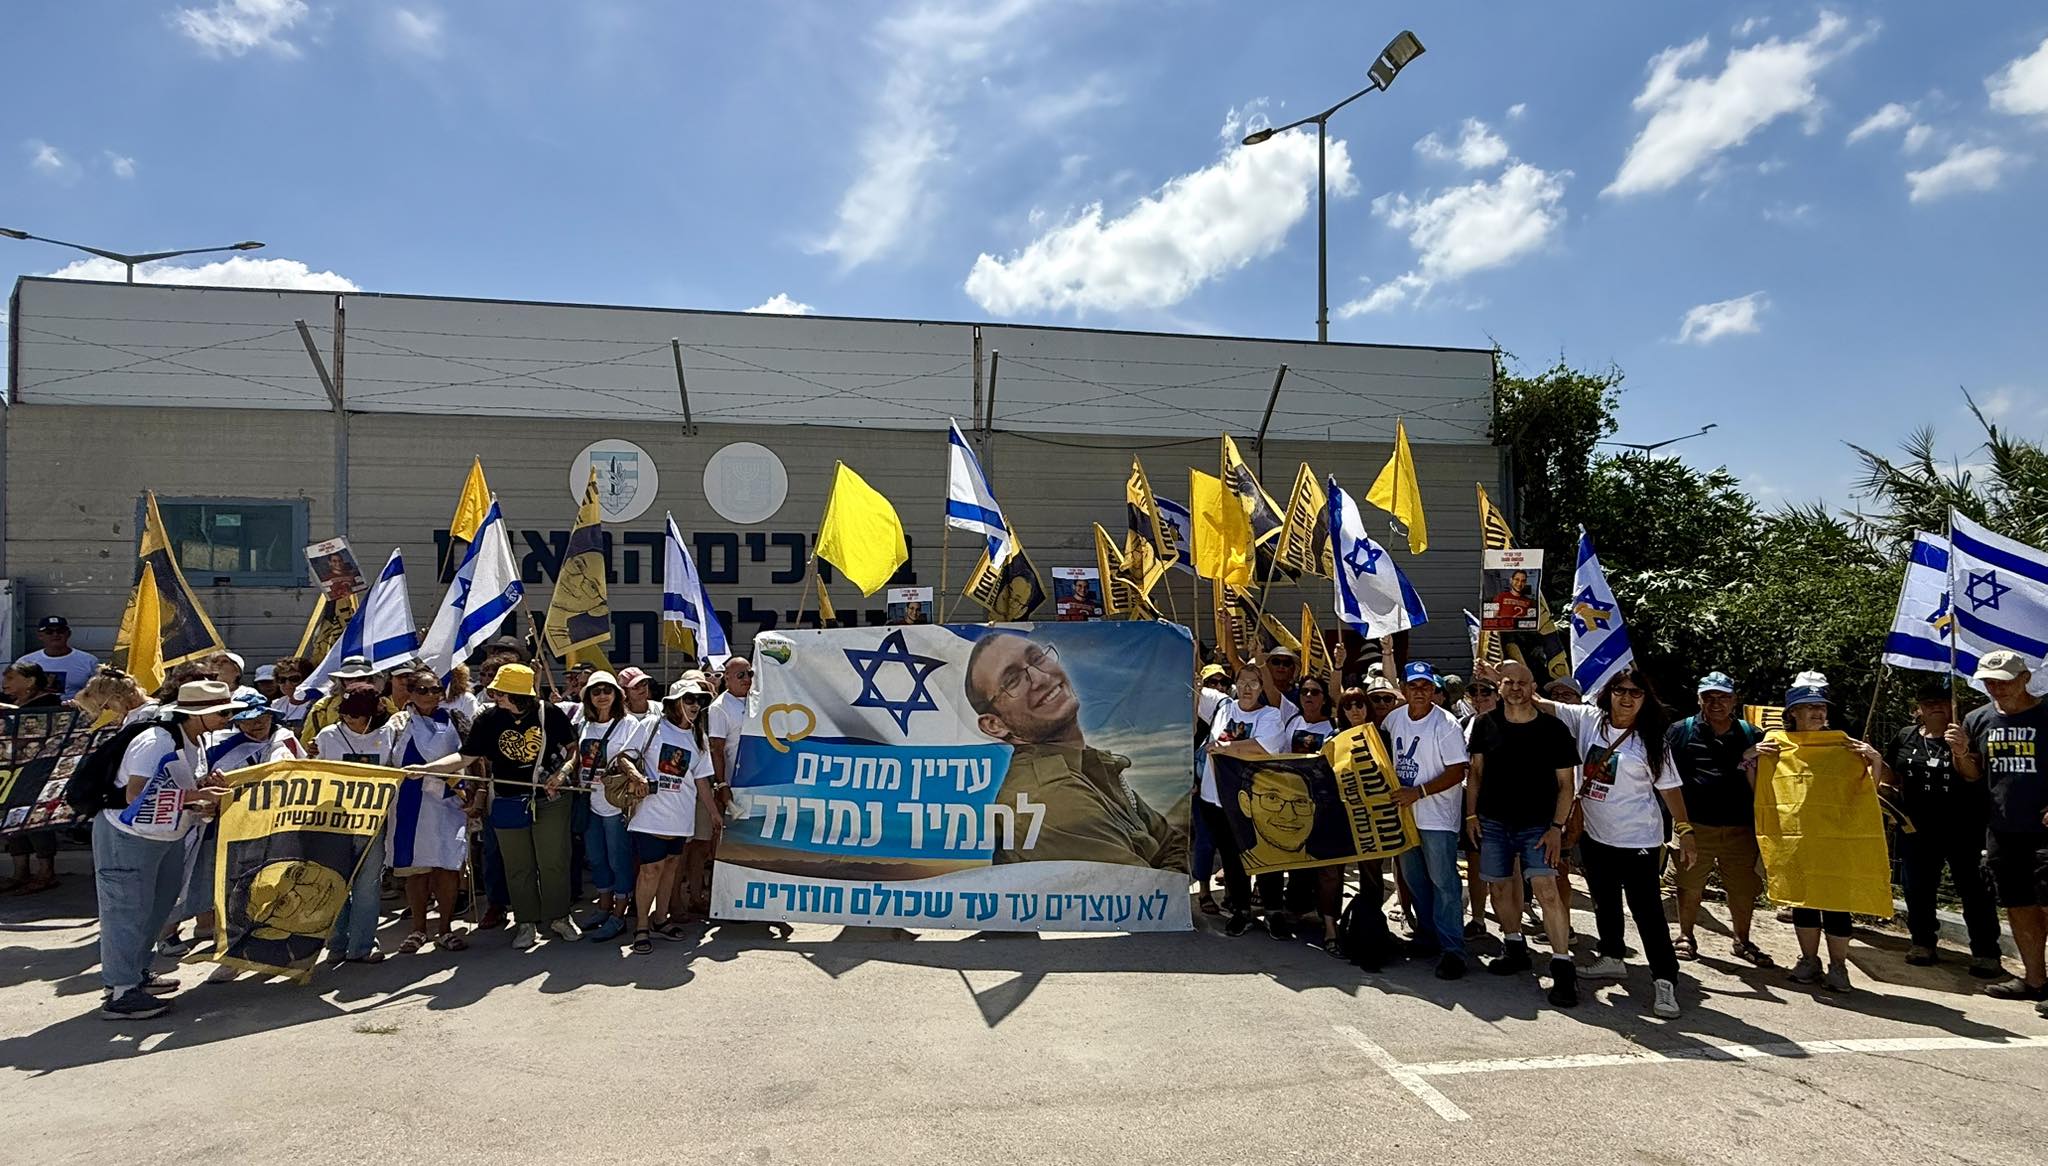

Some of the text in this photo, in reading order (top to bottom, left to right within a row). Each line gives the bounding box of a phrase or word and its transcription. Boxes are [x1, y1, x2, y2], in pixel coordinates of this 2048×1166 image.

[1987, 726, 2037, 742] למה הם
[1987, 741, 2036, 757] עדיין
[794, 752, 992, 800] עדיין מחכים
[1350, 731, 1392, 797] נמרודי
[1989, 756, 2038, 773] בעזה?
[232, 778, 397, 811] תמיר נמרודי
[274, 809, 328, 828] עכשיו!
[330, 811, 364, 829] כולם
[736, 792, 1047, 850] לתמיר נמרודי
[734, 881, 1169, 923] לא עוצרים עד עד שכולם חוזרים.
